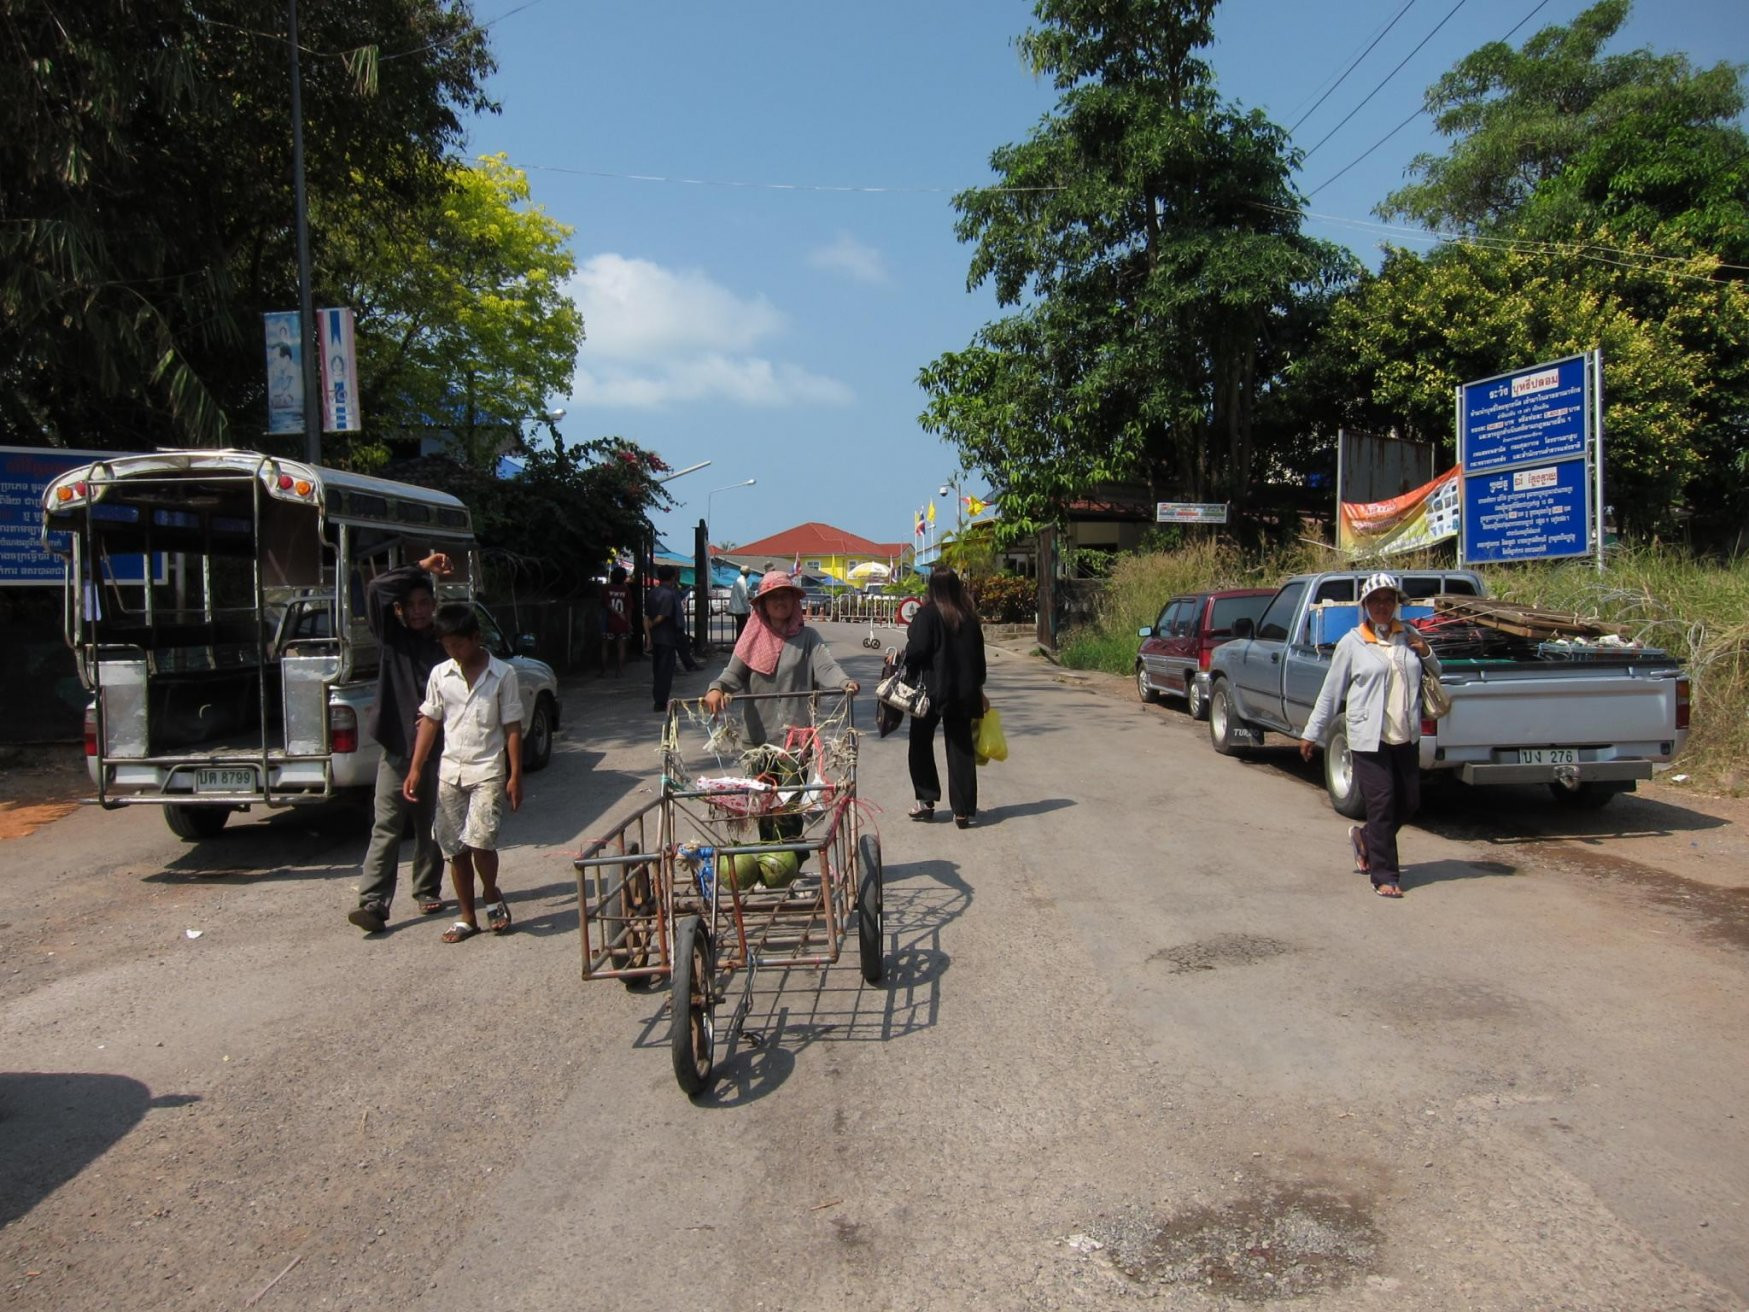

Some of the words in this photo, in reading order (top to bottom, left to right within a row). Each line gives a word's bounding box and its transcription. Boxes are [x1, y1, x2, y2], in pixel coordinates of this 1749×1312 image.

[1513, 375, 1558, 394] บุหรี่ปลอม
[1550, 750, 1573, 763] 276
[221, 771, 251, 784] 8799
